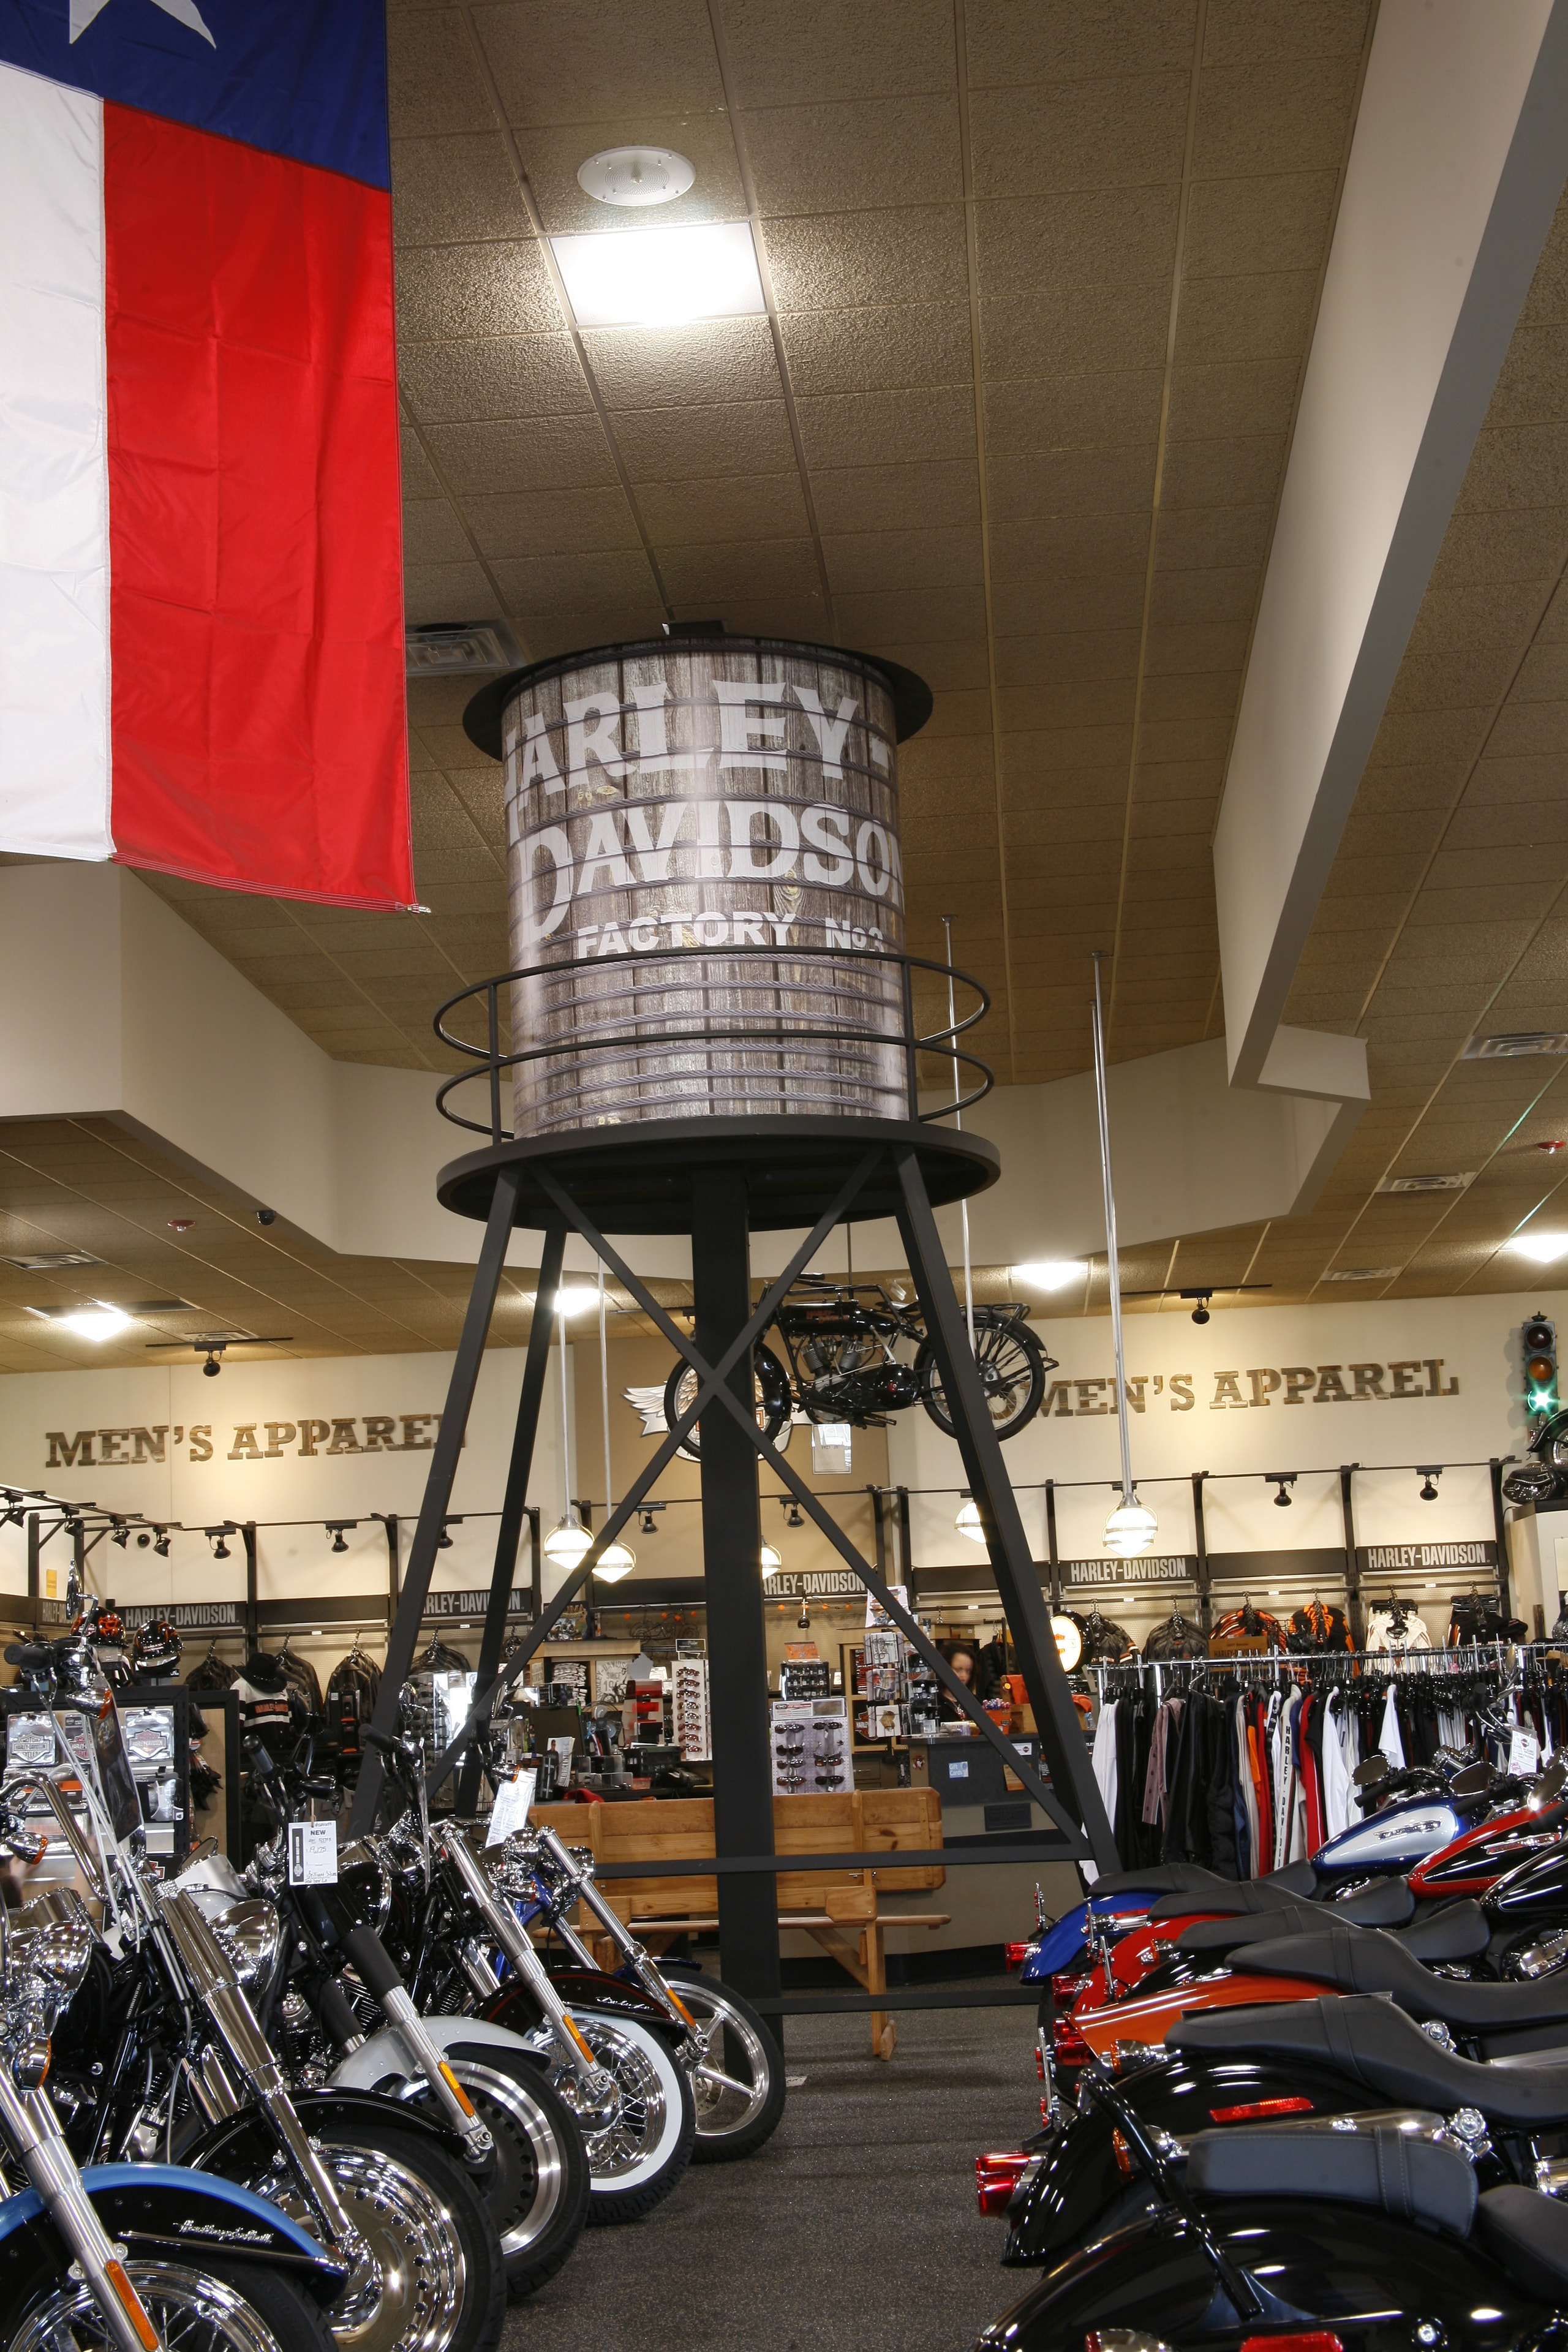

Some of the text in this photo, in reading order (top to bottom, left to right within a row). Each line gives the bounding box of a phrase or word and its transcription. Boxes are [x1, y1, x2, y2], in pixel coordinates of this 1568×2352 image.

[577, 911, 798, 959] FACTORY
[935, 1359, 1459, 1421] OMEN'S APPAREL
[45, 1425, 214, 1468] MEN'S
[1071, 1558, 1186, 1582] HARLEY-DAVIDSON
[1368, 1544, 1486, 1568] HARLEY-DAVIDSON
[763, 1572, 865, 1594] ARLEY-DAVIDSON
